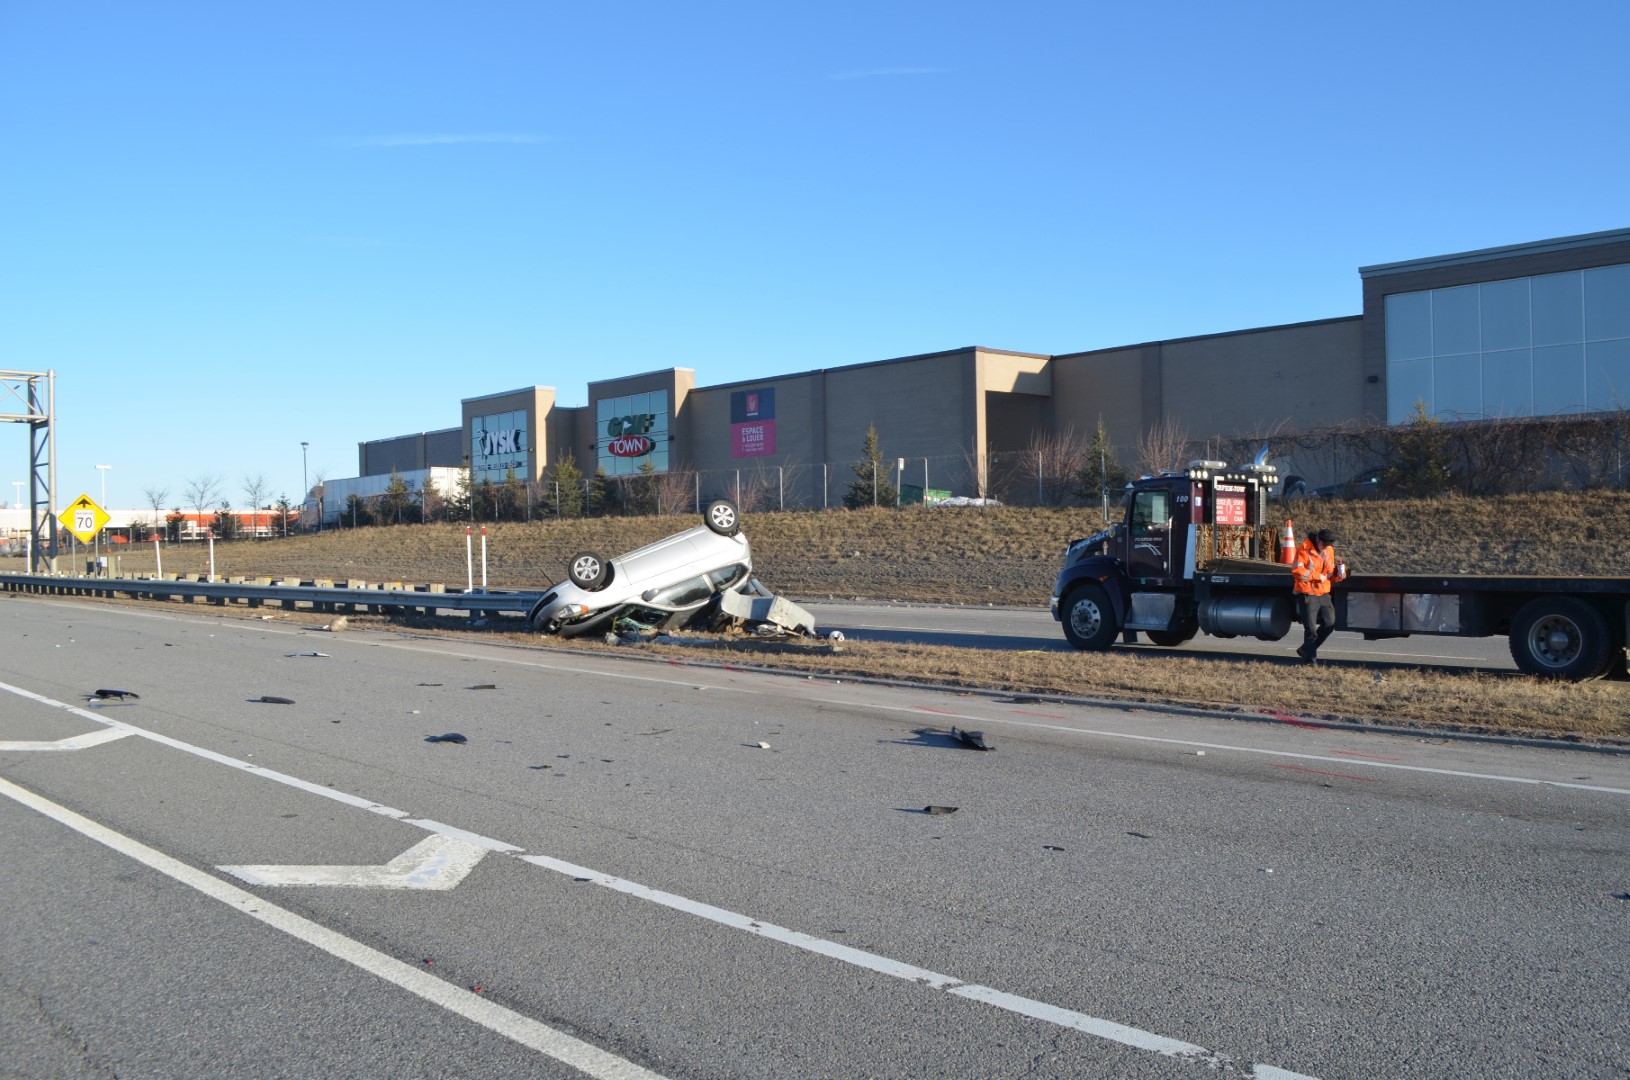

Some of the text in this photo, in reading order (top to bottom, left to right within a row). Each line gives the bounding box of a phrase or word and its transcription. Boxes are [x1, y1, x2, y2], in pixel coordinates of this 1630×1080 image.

[741, 426, 764, 435] ESPACE
[483, 429, 517, 455] JYSK
[746, 433, 764, 442] LOUER
[613, 437, 644, 454] TOWN
[1176, 495, 1189, 503] 100
[77, 517, 93, 529] 70
